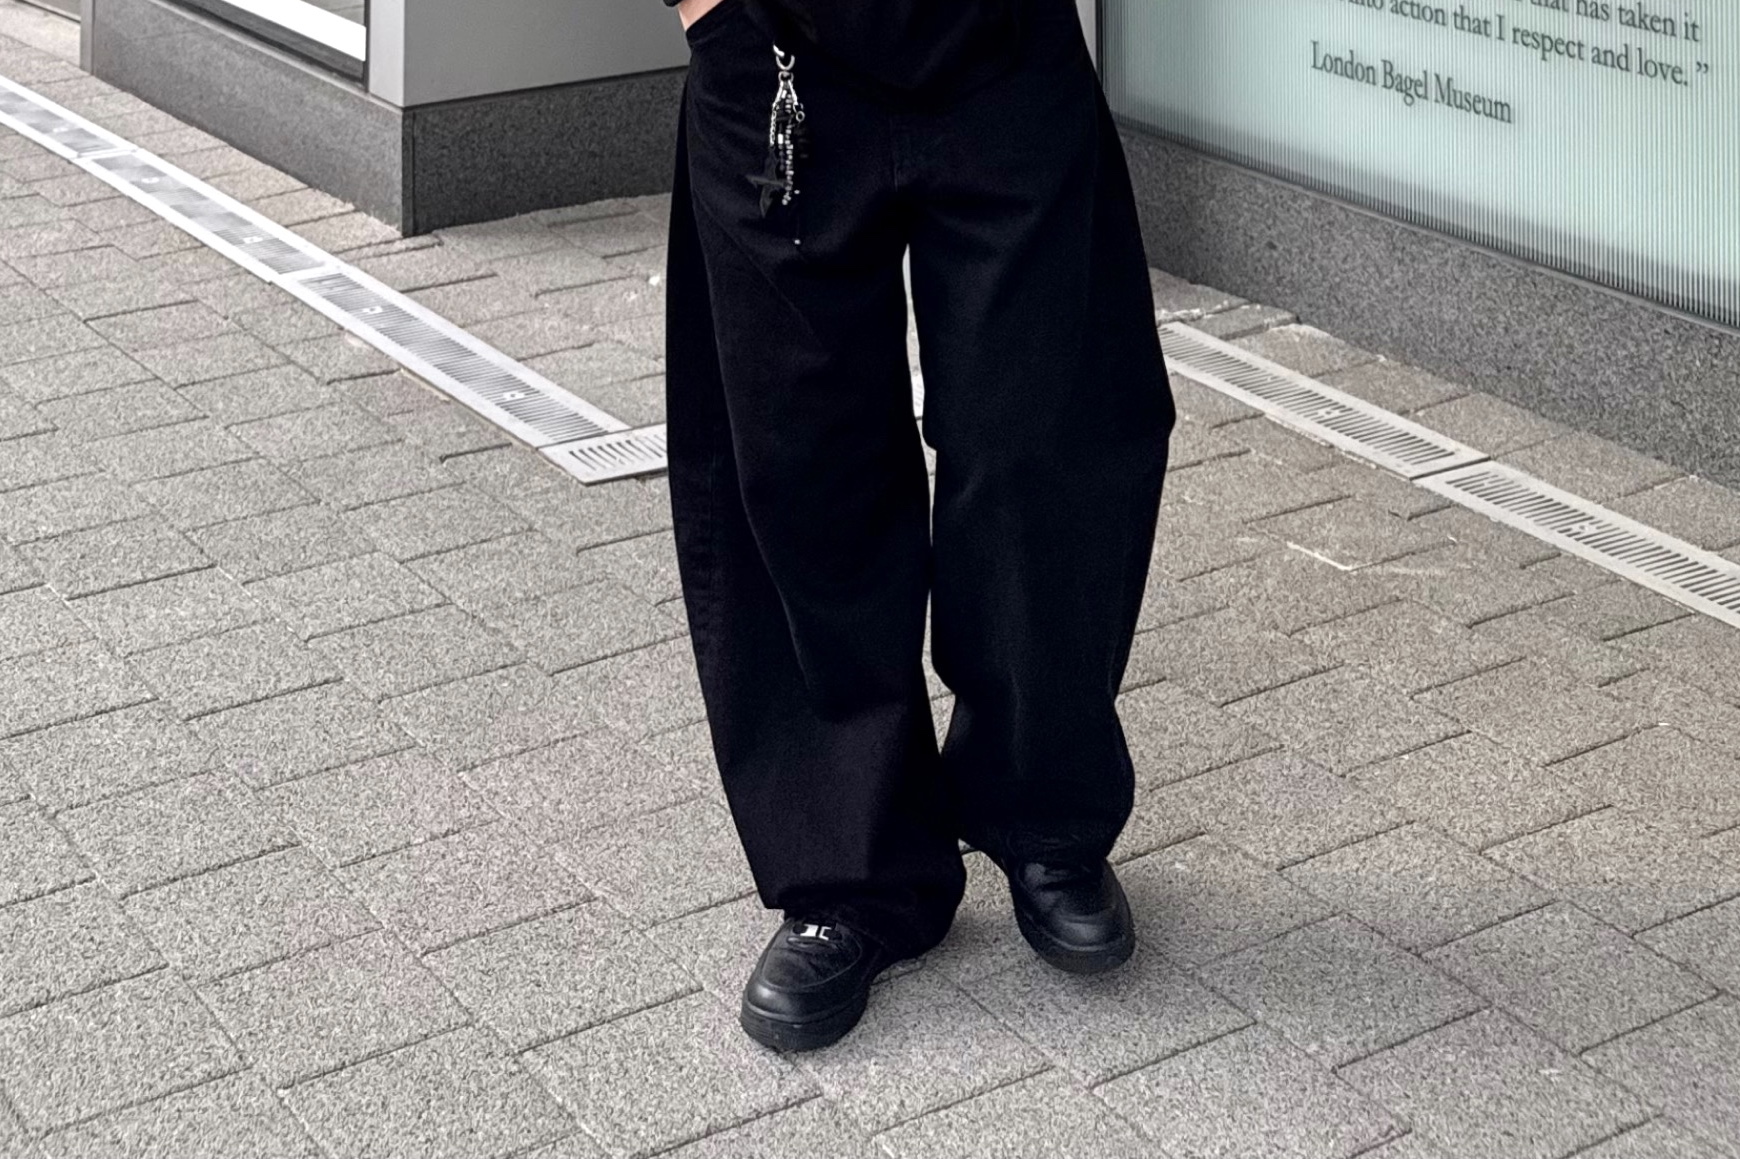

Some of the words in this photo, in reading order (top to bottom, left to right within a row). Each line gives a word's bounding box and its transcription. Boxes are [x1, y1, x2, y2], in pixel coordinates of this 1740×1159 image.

[1453, 5, 1491, 38] that
[1495, 14, 1505, 41] I
[1511, 26, 1585, 62] respect
[1591, 43, 1631, 73] and
[1618, 1, 1677, 38] taken
[1683, 12, 1701, 42] it
[1311, 39, 1377, 86] London
[1381, 58, 1429, 107] Bagel
[1434, 73, 1513, 124] Museum
